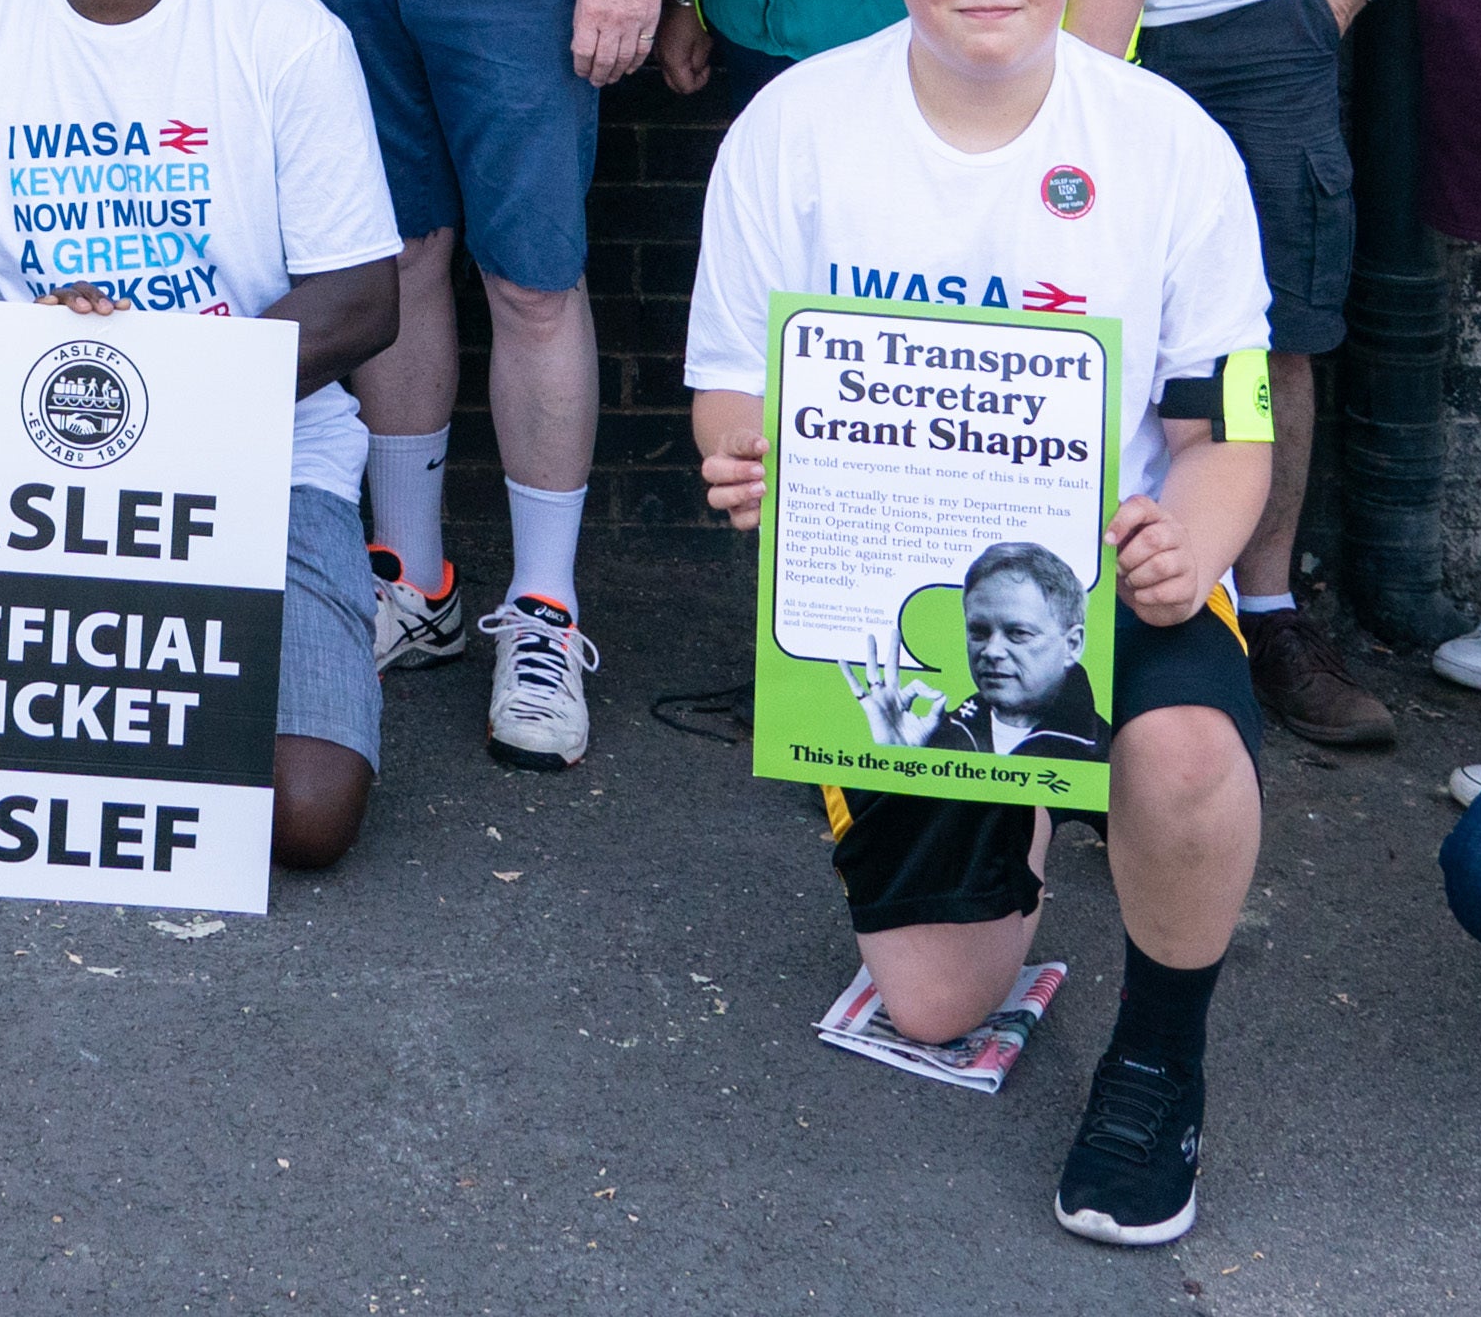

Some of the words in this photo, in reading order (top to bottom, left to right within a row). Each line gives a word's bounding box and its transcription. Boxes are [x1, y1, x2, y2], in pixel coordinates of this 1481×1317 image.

[9, 126, 15, 159] I
[23, 122, 118, 158] WAS
[124, 122, 150, 156] A
[10, 163, 210, 196] KEYWORKER
[14, 202, 88, 232] NOW
[97, 199, 138, 228] I'M
[21, 240, 45, 274] A
[53, 232, 211, 275] GREEDY
[851, 266, 967, 305] WAS
[982, 276, 1009, 309] A
[59, 345, 117, 362] ASLEF
[796, 326, 864, 361] I'm
[878, 332, 1091, 382] Transport
[839, 370, 1047, 424] Secretary
[98, 430, 134, 459] 1880
[795, 407, 916, 448] Grant
[929, 418, 1088, 466] Shapps
[788, 454, 809, 464] I've
[814, 455, 837, 467] told
[843, 458, 900, 474] everyone
[905, 463, 931, 475] that
[936, 467, 968, 479] none
[973, 469, 985, 480] of
[989, 471, 1014, 482] this
[1018, 474, 1029, 484] is
[1034, 476, 1054, 488] my
[1059, 476, 1093, 490] fault.
[787, 499, 835, 513] ignored
[840, 503, 877, 515] Trade
[882, 506, 932, 521] Unions,
[937, 512, 1001, 527] prevented
[1006, 516, 1027, 528] the
[788, 482, 831, 497] What's
[836, 488, 886, 504] actually
[892, 493, 919, 504] true
[924, 494, 935, 505] is
[939, 497, 959, 509] my
[964, 498, 1042, 516] Department
[1047, 505, 1071, 516] has
[786, 512, 821, 525] Train
[894, 522, 967, 538] Companies
[973, 528, 1002, 540] from
[790, 744, 833, 765] This
[837, 750, 854, 766] is
[858, 753, 889, 771] the
[894, 759, 927, 777] age
[932, 761, 952, 777] of
[955, 764, 986, 779] the
[991, 765, 1030, 787] tory
